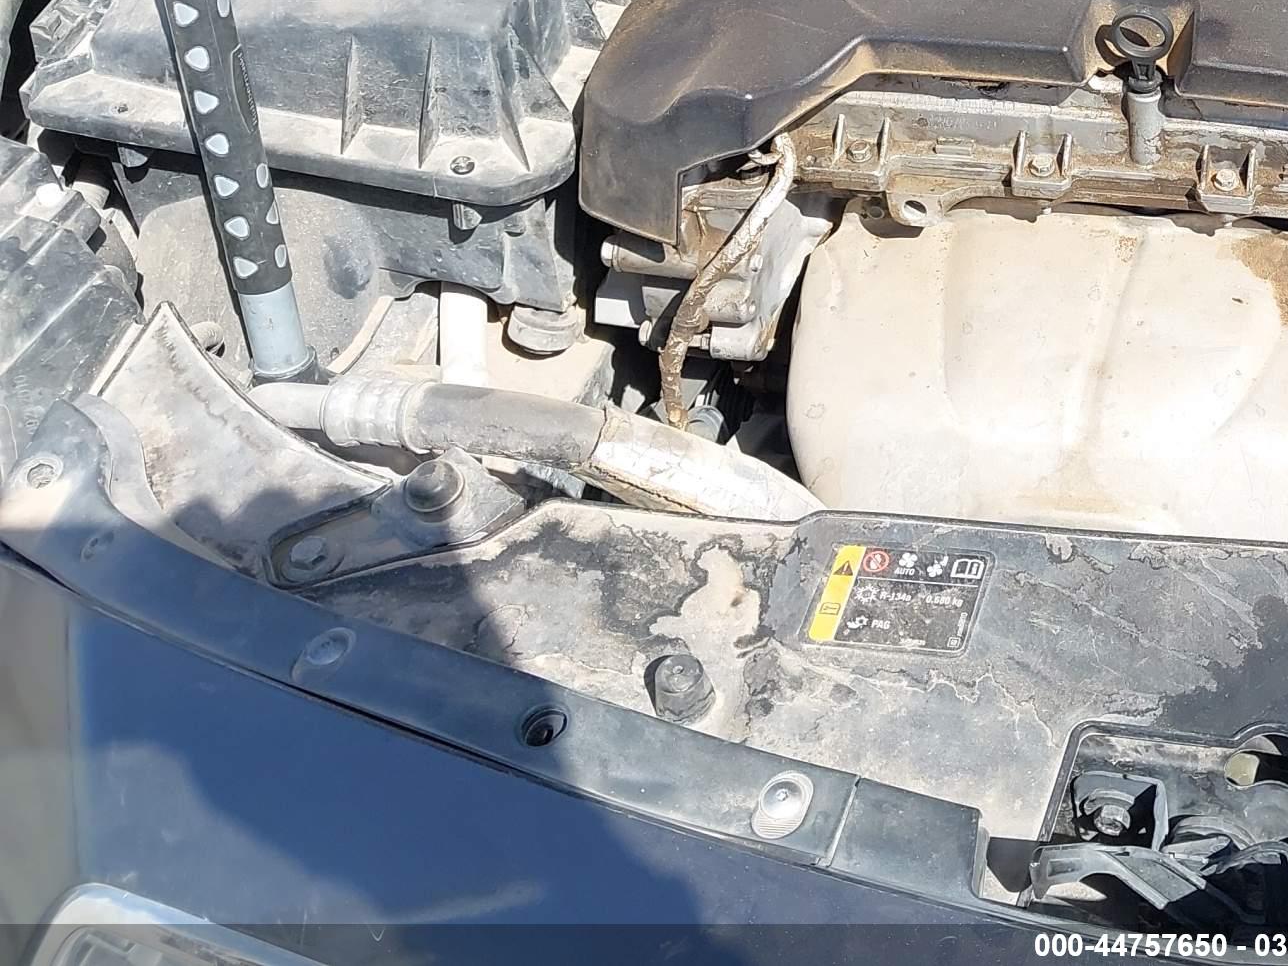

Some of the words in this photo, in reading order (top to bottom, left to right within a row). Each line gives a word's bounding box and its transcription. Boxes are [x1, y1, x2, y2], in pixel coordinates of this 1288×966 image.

[894, 567, 916, 576] AUTO
[880, 591, 912, 602] R-134a
[952, 596, 964, 608] kg
[871, 619, 891, 630] PAG
